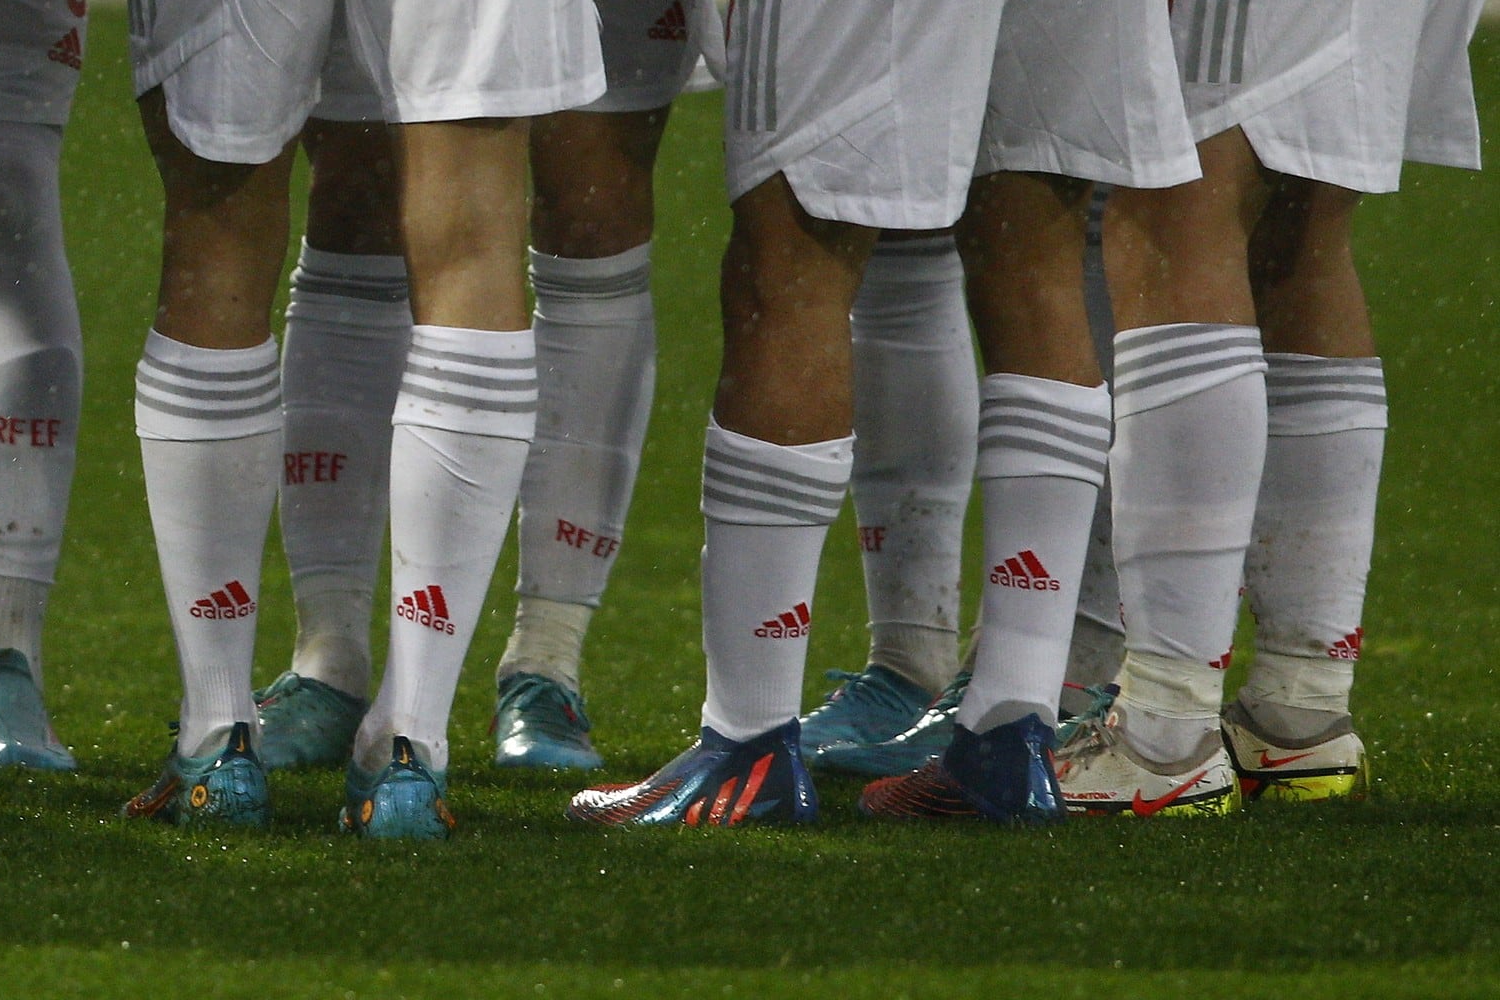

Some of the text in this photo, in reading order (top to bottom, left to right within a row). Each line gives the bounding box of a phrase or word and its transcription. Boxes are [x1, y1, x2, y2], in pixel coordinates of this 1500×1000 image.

[284, 451, 348, 486] RFEF
[556, 518, 620, 559] RFEF
[990, 571, 1060, 591] adidas
[190, 601, 256, 620] adidas
[396, 604, 456, 636] adidas
